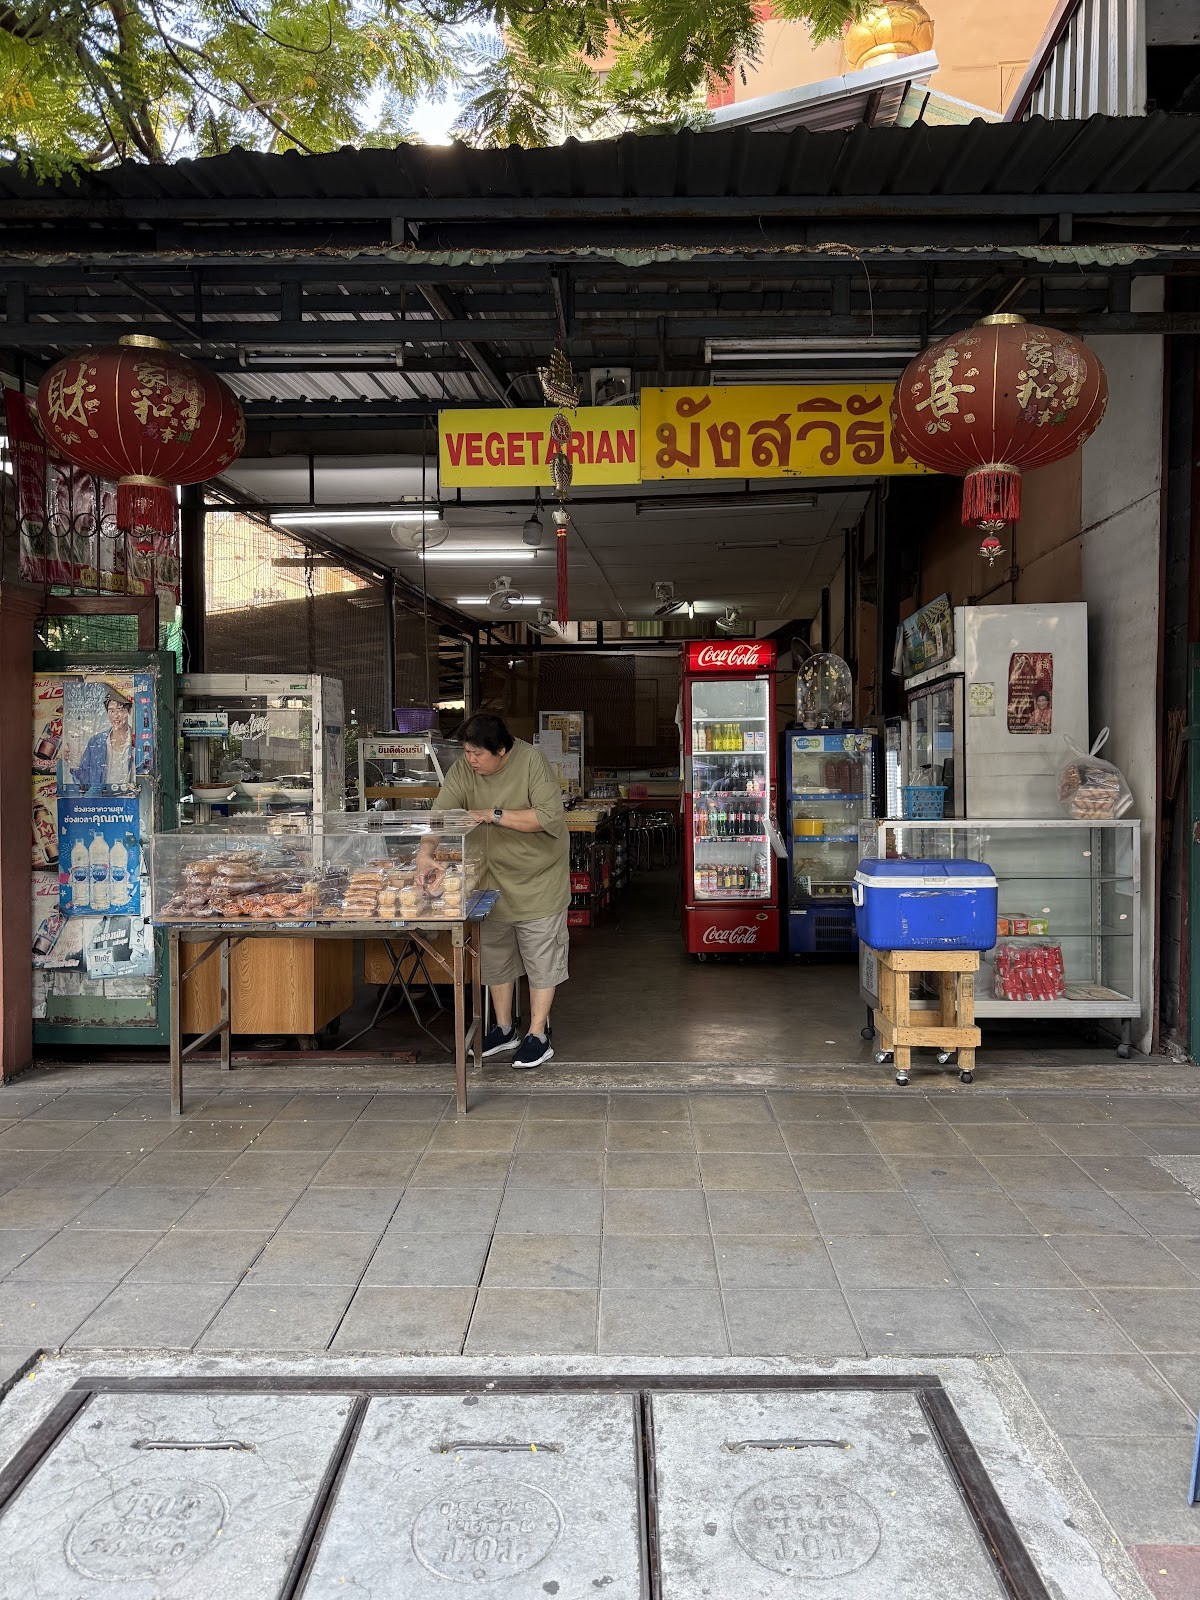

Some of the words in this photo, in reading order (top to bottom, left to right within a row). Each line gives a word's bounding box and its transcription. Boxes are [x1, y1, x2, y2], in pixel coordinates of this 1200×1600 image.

[47, 363, 89, 427] 財
[914, 348, 976, 419] 喜
[445, 430, 636, 467] VEGETARIAN
[697, 644, 762, 667] Coca-Cola
[378, 744, 423, 754] ยินดีต้อนรับ
[73, 805, 124, 814] ช่วงเวลาความสุข
[703, 925, 760, 945] Coca-Cola
